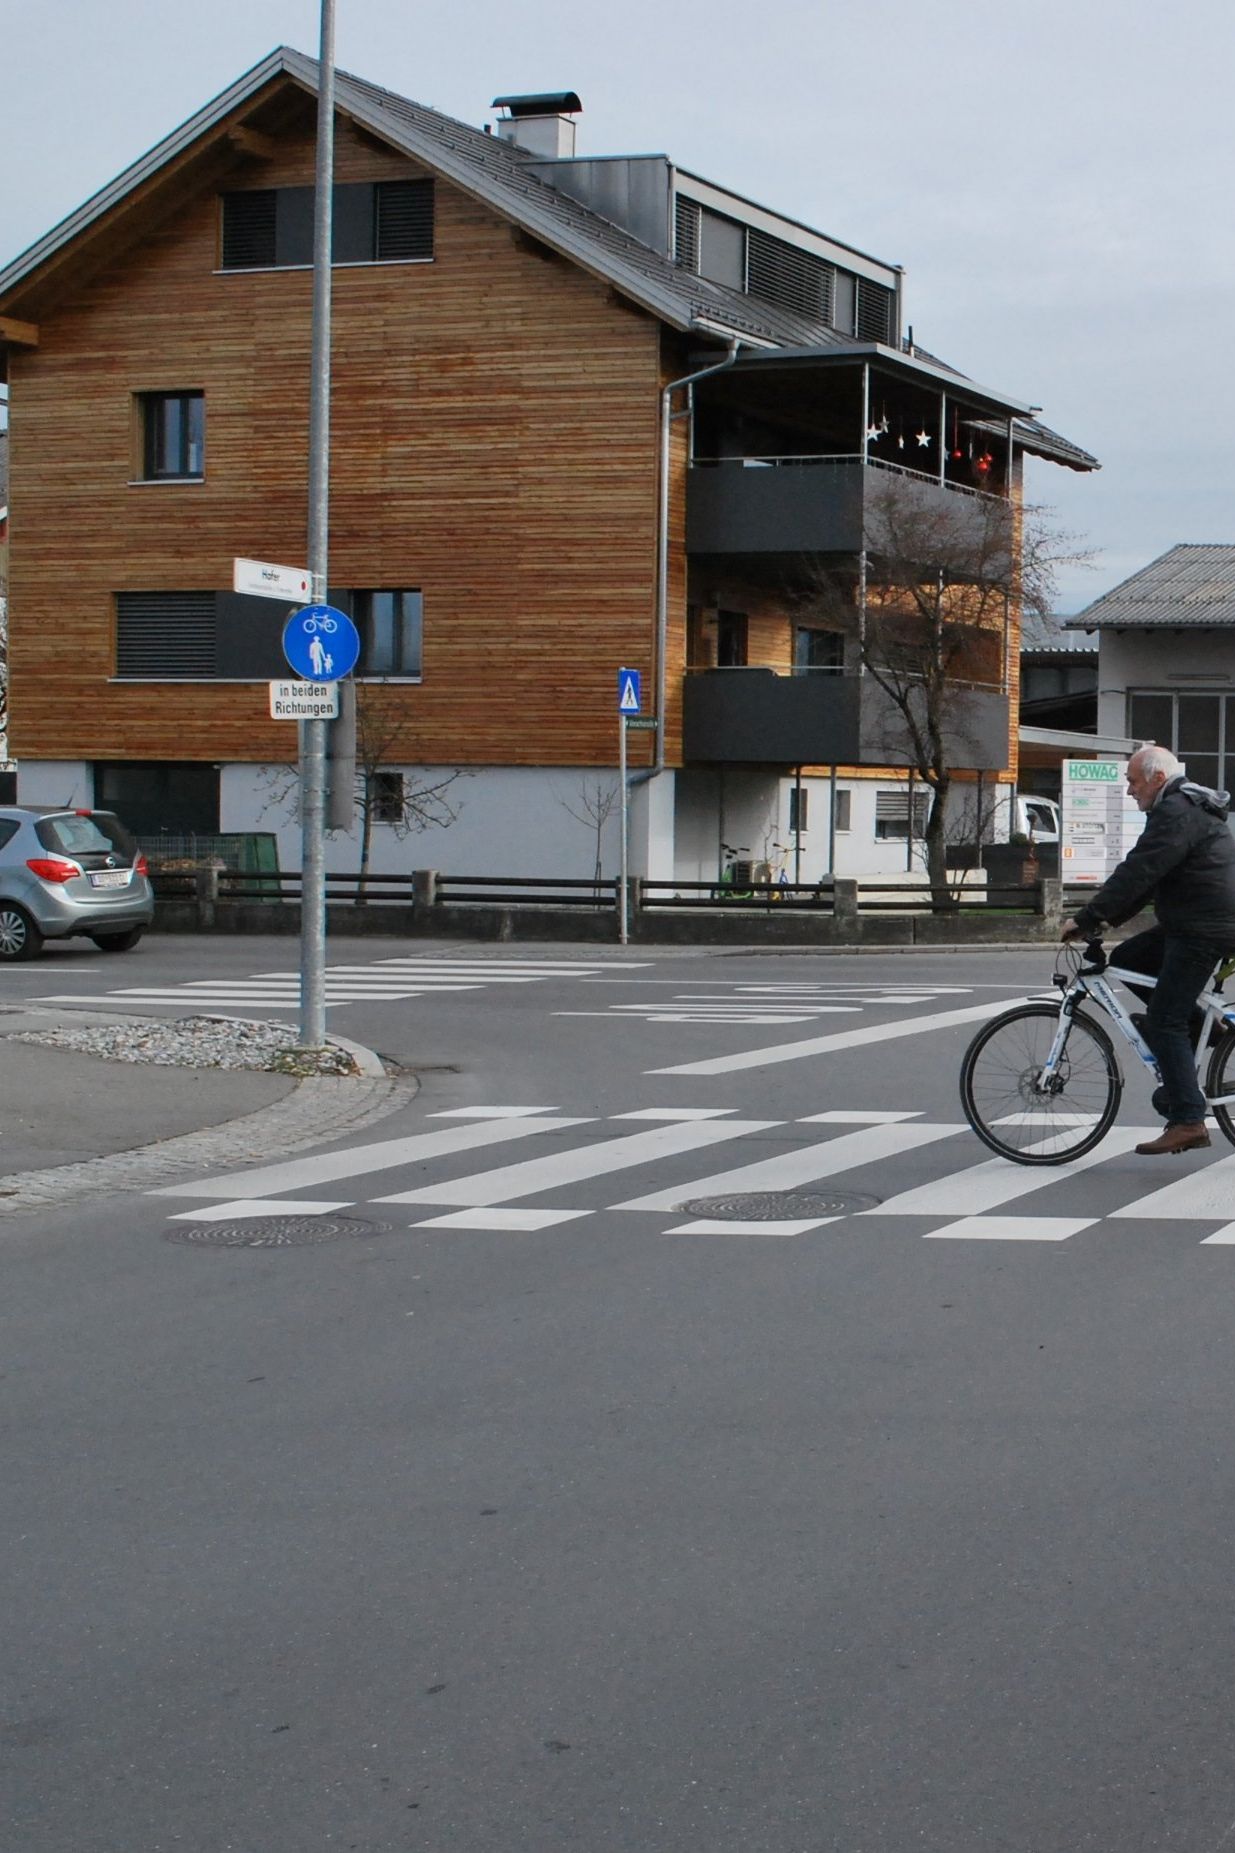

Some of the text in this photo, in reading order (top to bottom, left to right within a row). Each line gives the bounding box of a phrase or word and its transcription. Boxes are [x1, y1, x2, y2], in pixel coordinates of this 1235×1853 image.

[280, 684, 327, 697] in beiden
[275, 701, 333, 716] Richtungen
[1069, 764, 1118, 779] HOWAG
